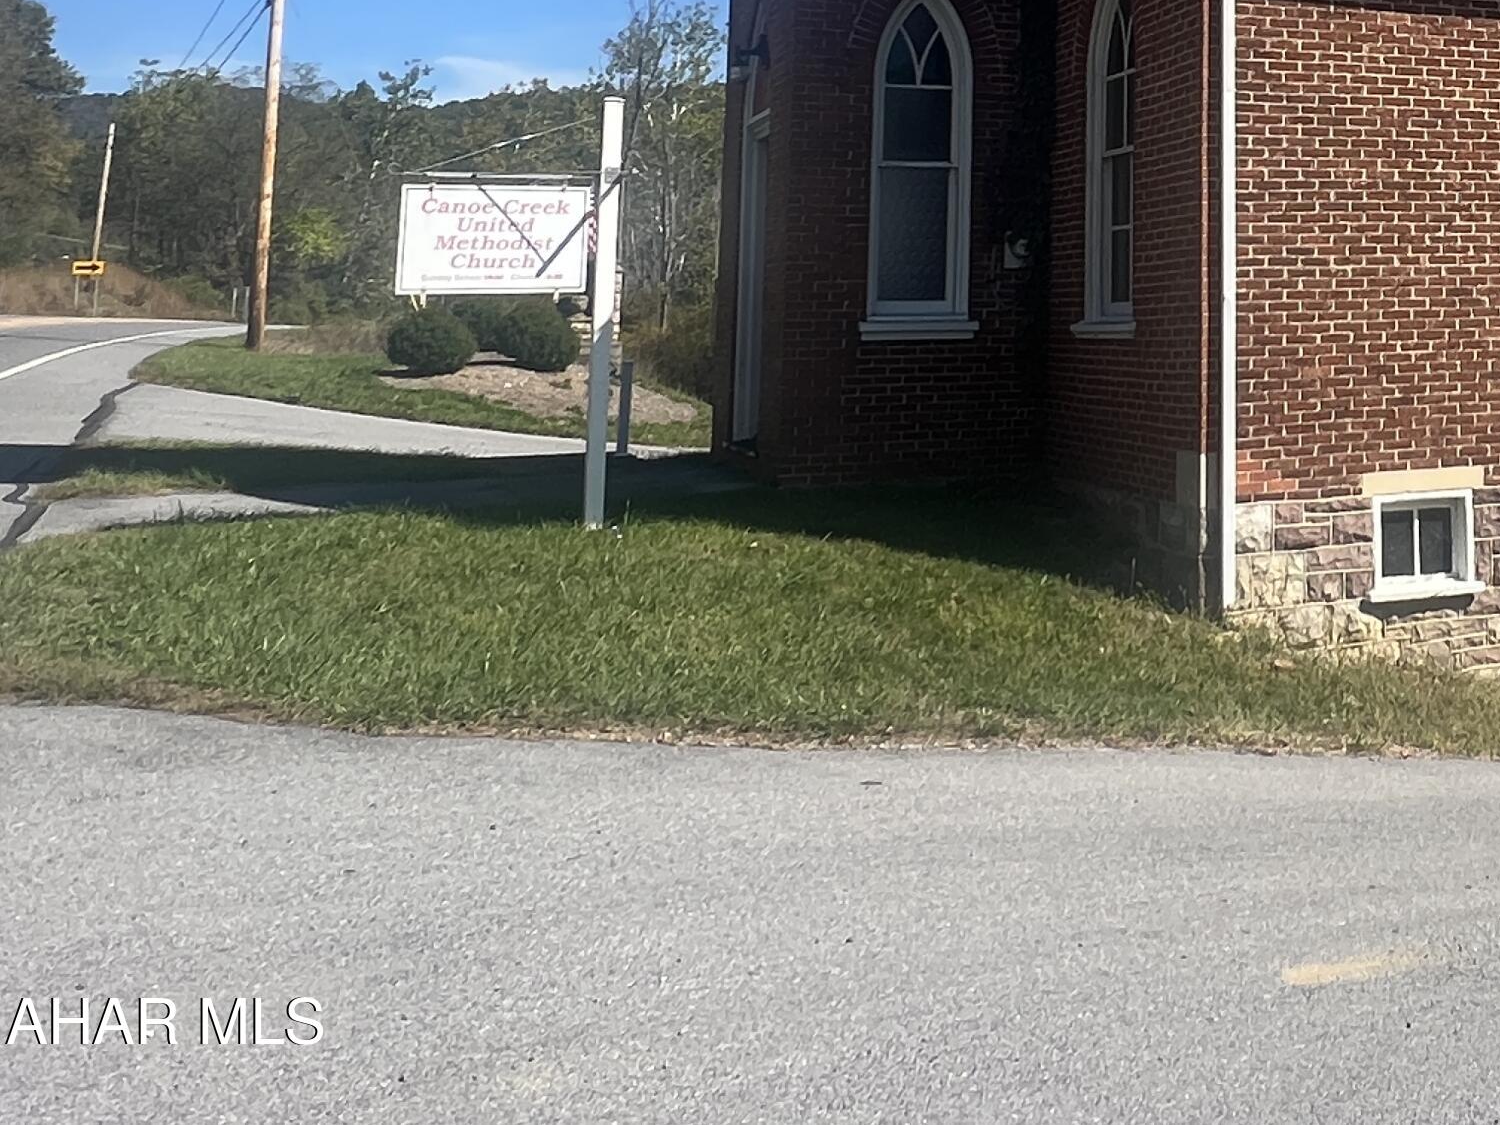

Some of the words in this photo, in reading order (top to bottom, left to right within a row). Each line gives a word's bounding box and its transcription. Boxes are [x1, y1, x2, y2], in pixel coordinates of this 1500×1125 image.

[421, 198, 495, 214] Canoe
[503, 199, 570, 214] Creek
[457, 217, 535, 232] United
[433, 235, 554, 250] Methodist
[450, 253, 536, 269] Church
